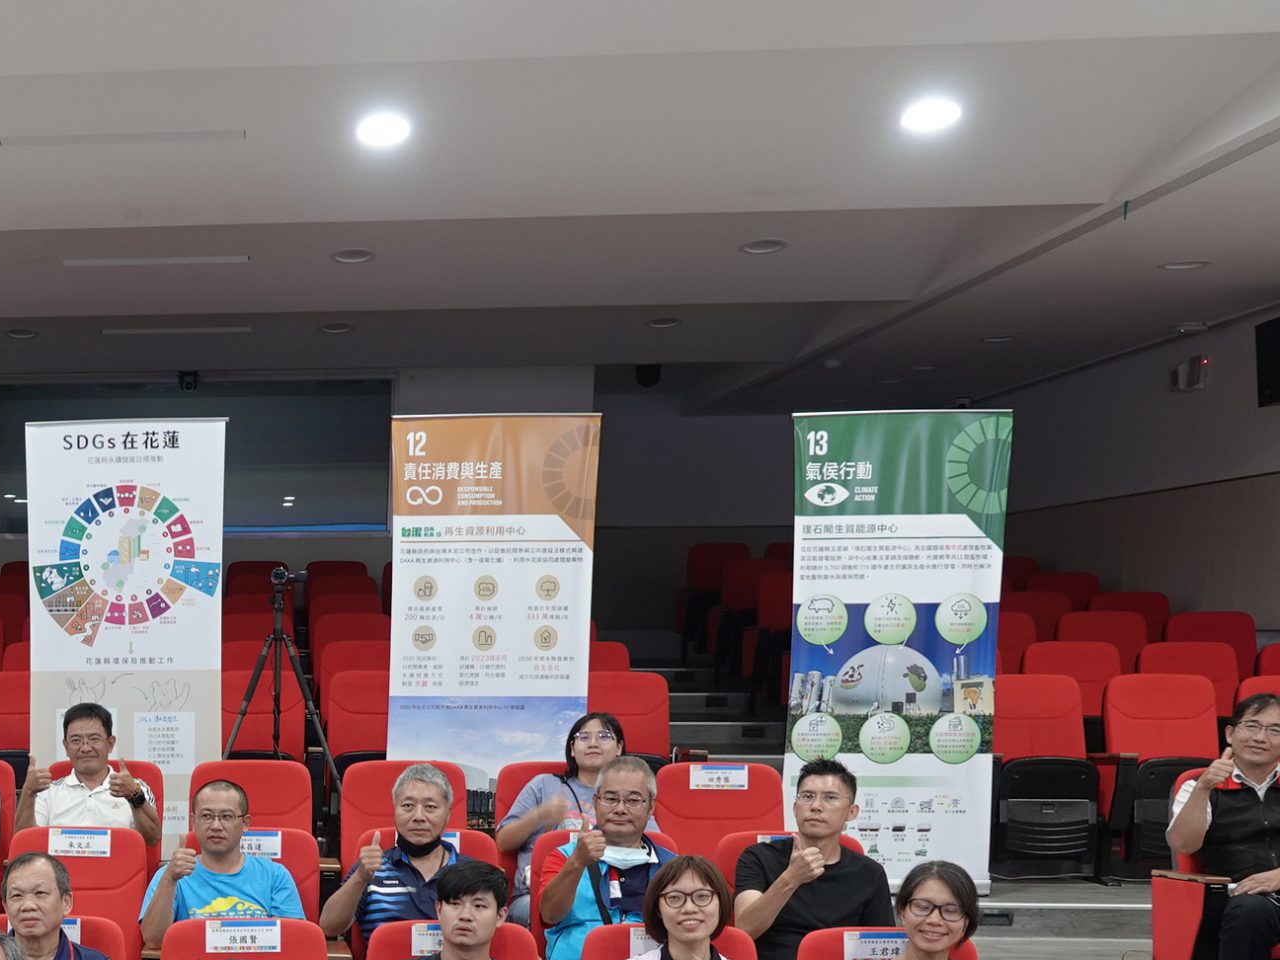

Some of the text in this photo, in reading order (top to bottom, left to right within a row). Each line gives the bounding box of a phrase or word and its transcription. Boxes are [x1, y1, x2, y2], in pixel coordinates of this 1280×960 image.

[63, 430, 180, 450] SDGs 在花蓮
[406, 431, 427, 456] 12
[807, 431, 828, 456] 13
[404, 461, 503, 480] 責任消費與生產
[854, 486, 878, 494] CLIMATE
[854, 494, 875, 502] ACTION
